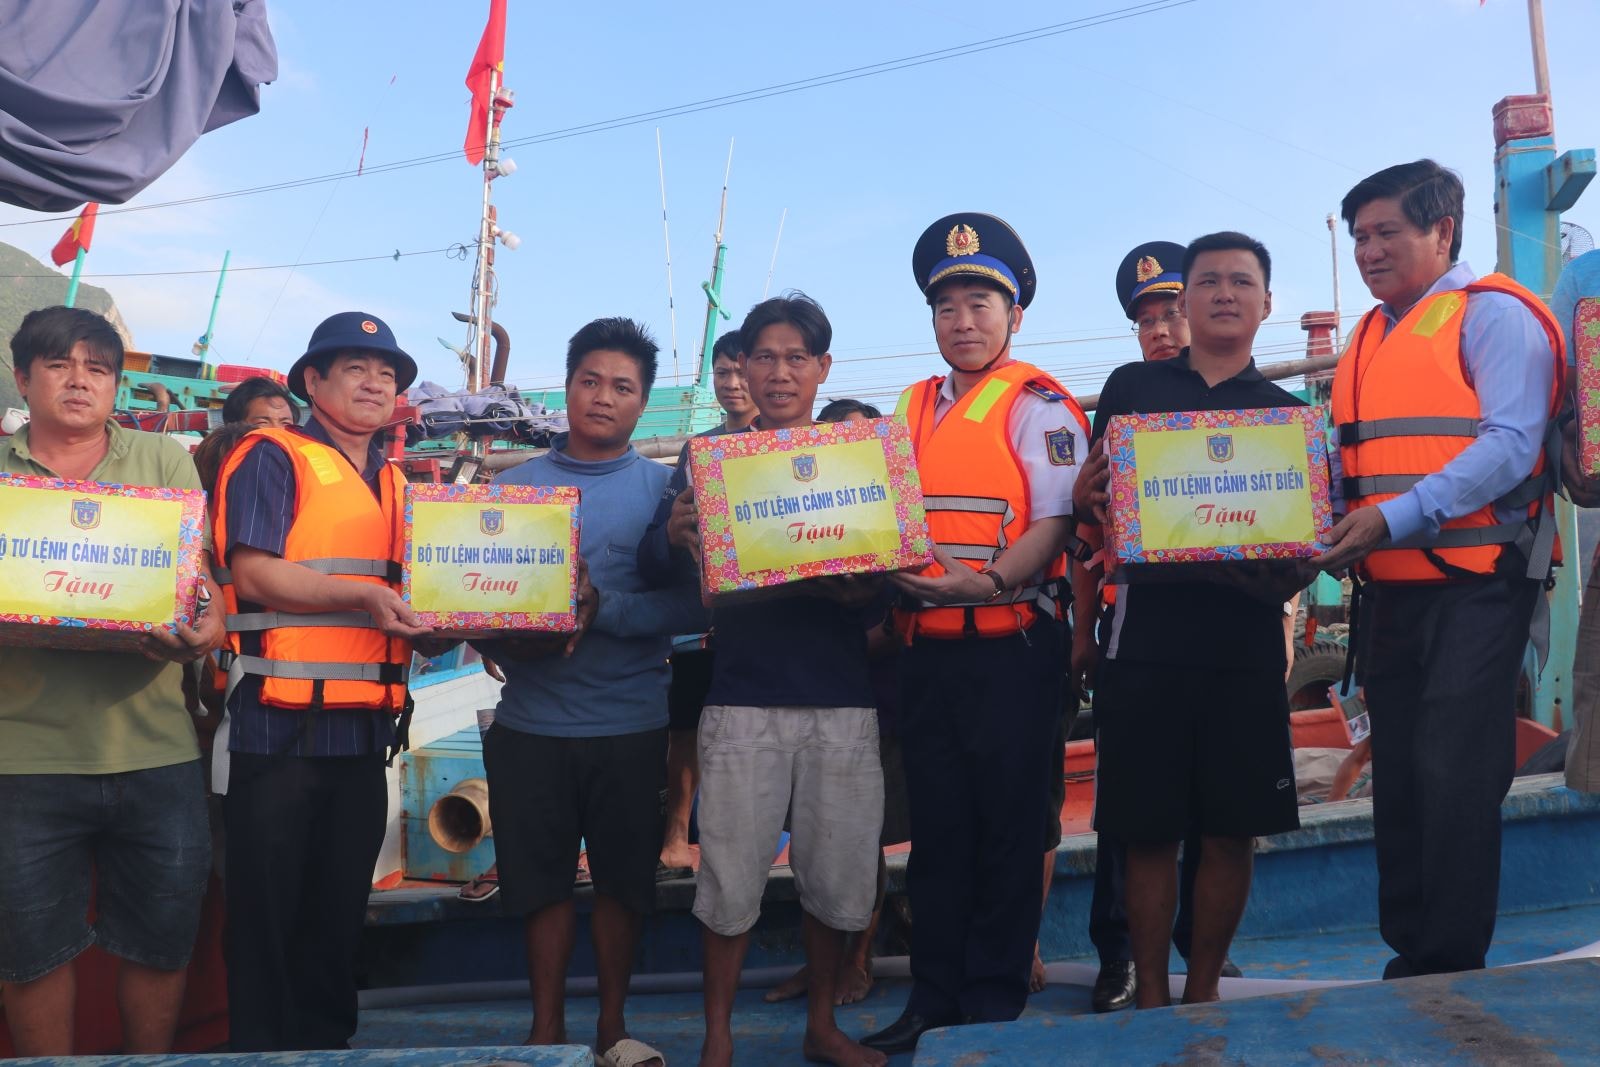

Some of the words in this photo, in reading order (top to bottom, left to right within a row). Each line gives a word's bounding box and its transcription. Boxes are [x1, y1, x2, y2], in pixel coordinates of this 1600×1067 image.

[1143, 476, 1160, 501] BỘ
[1163, 477, 1178, 496] TƯ
[1181, 474, 1212, 499] LỆNH
[1214, 470, 1247, 494] CẢNH
[1250, 470, 1272, 491] SÁT
[1276, 465, 1303, 490] BIỂN
[735, 501, 751, 524] BỘ
[753, 499, 769, 519] TƯ
[770, 495, 800, 519] LỆNH
[802, 488, 834, 511] CẢNH
[836, 486, 857, 506] SÁT
[859, 479, 887, 503] BIỂN
[1194, 504, 1257, 527] Tặng
[787, 522, 846, 544] Tặng
[0, 533, 7, 560] Ộ
[12, 538, 31, 558] TƯ
[32, 537, 68, 563] LỆNH
[71, 537, 109, 564] CẢNH
[112, 544, 138, 566] SÁT
[141, 543, 172, 568] BIỂN
[417, 543, 432, 566] BỘ
[435, 545, 450, 563] TƯ
[452, 544, 480, 567] LỆNH
[483, 542, 512, 564] CẢNH
[516, 545, 537, 565] SÁT
[539, 542, 565, 565] BIỂN
[43, 570, 114, 600] Tặng
[462, 572, 519, 595] Tặng
